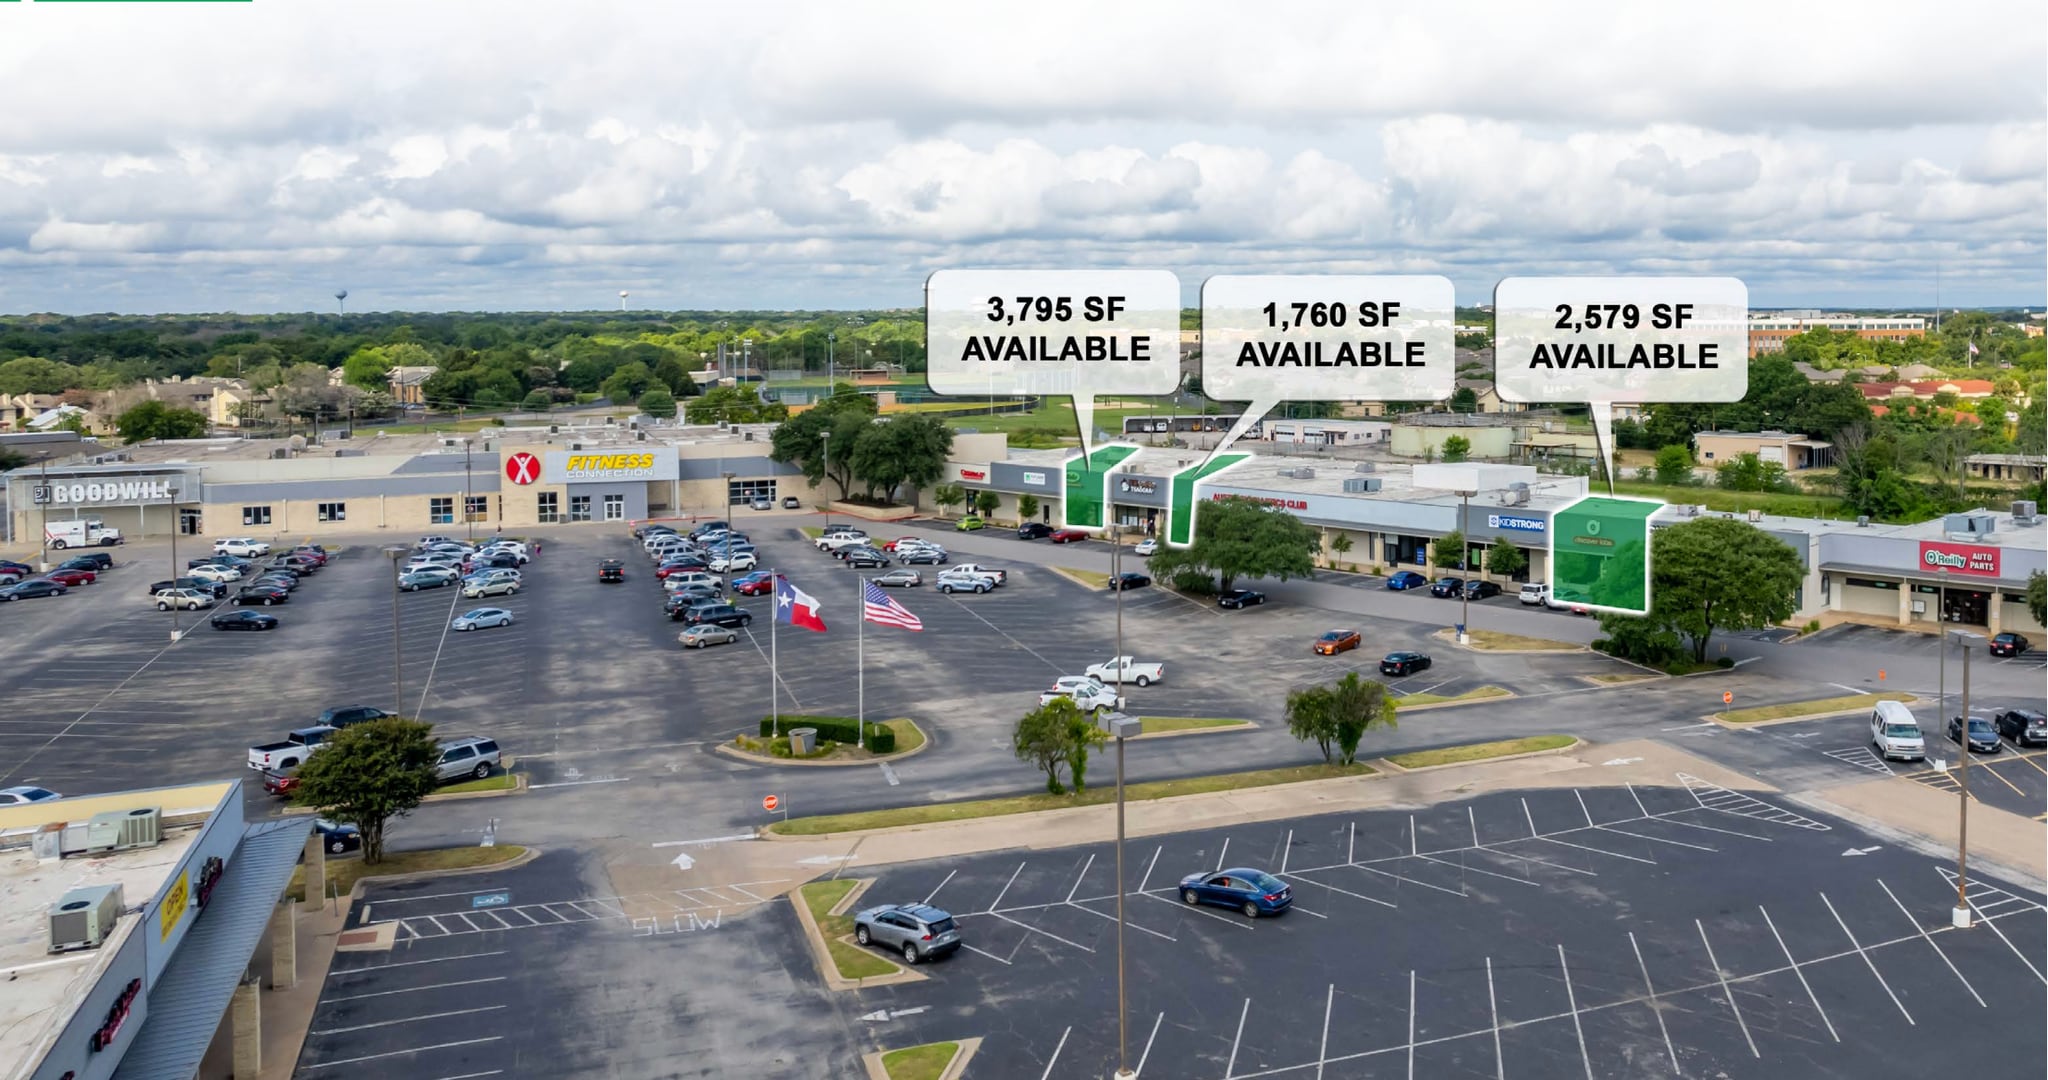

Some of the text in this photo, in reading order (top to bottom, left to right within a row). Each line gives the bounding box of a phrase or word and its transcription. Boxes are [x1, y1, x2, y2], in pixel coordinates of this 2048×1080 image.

[566, 453, 655, 471] FITNESS
[566, 469, 654, 479] CONNECTION
[53, 480, 173, 504] GOODWILL
[1286, 500, 1308, 511] CLUB
[1500, 517, 1545, 530] KIDSTRONG
[1925, 550, 1993, 568] O'Reilly AUTO
[1970, 561, 1994, 571] PARTS
[632, 909, 722, 937] SLOW
